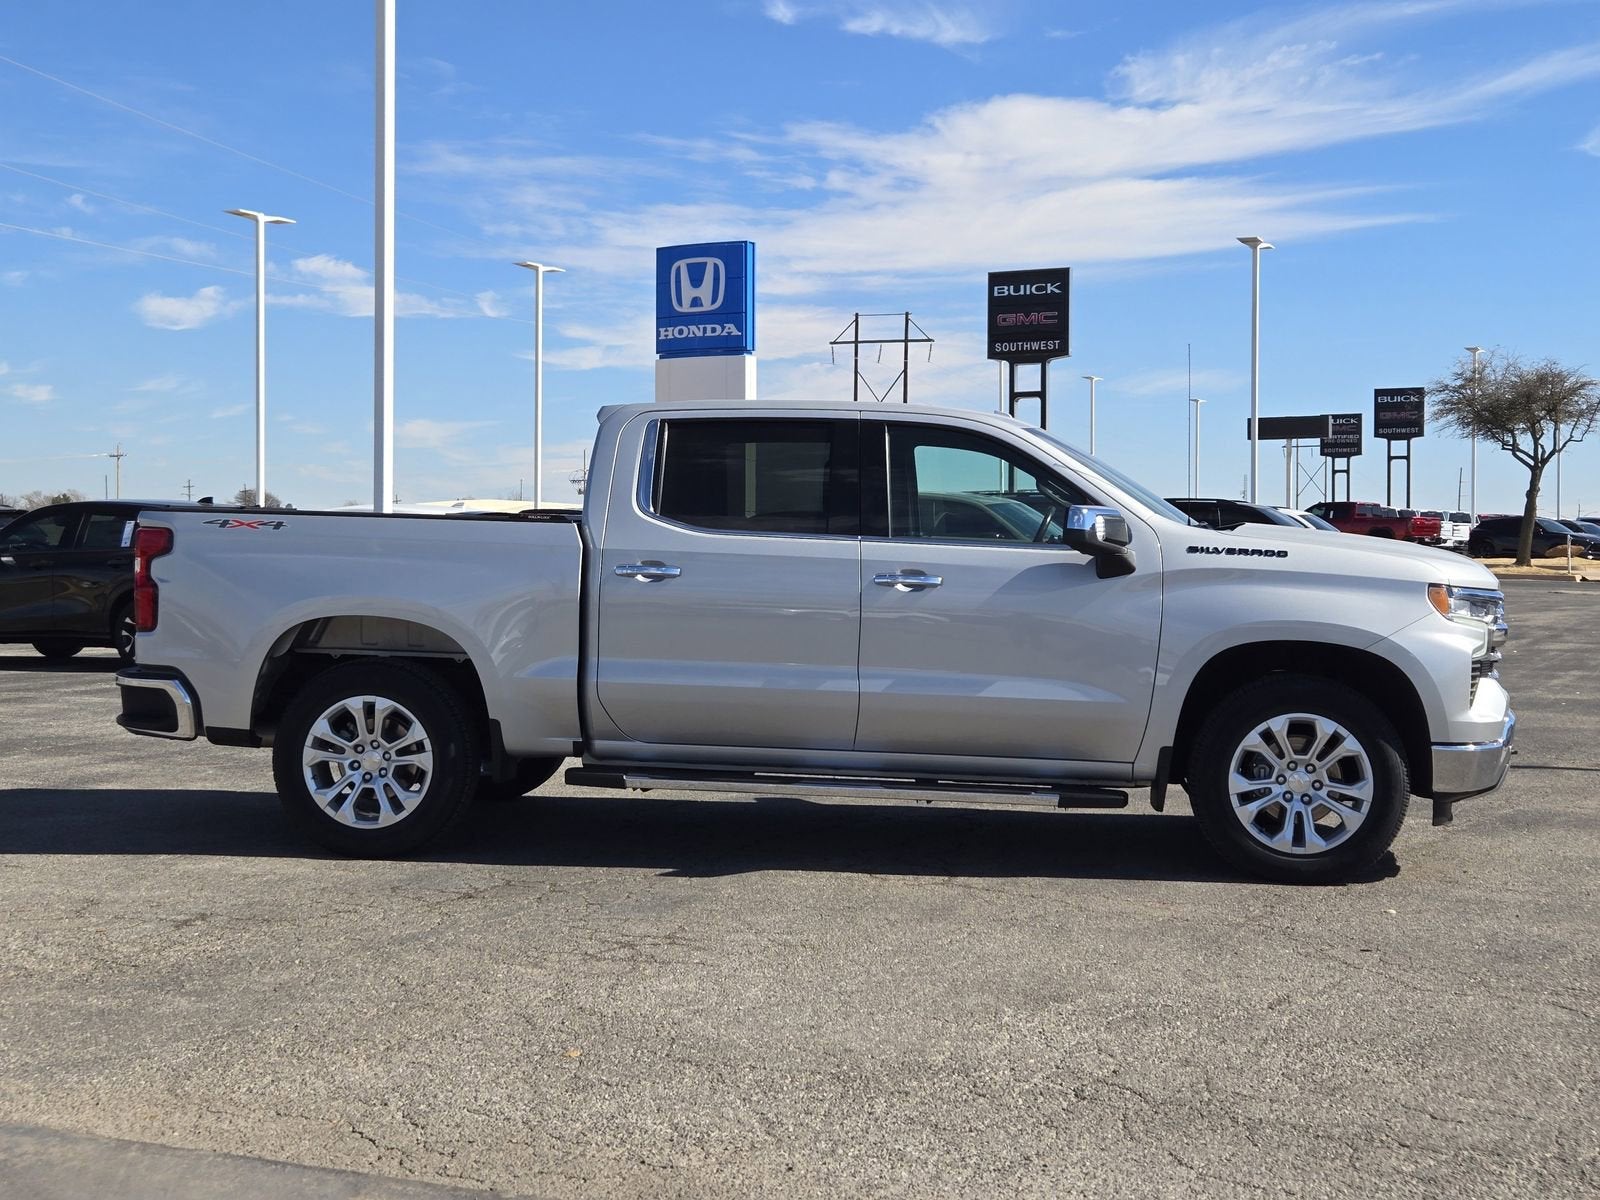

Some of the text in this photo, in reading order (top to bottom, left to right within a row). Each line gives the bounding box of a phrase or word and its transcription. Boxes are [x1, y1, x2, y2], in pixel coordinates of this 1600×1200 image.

[993, 282, 1062, 297] BUICK
[997, 311, 1058, 326] GMC
[658, 323, 742, 340] HONDA
[995, 340, 1060, 352] SOUTHWEST
[1377, 394, 1420, 403] BUICK
[1379, 411, 1418, 420] GMC
[1185, 545, 1289, 558] SILVERADO
